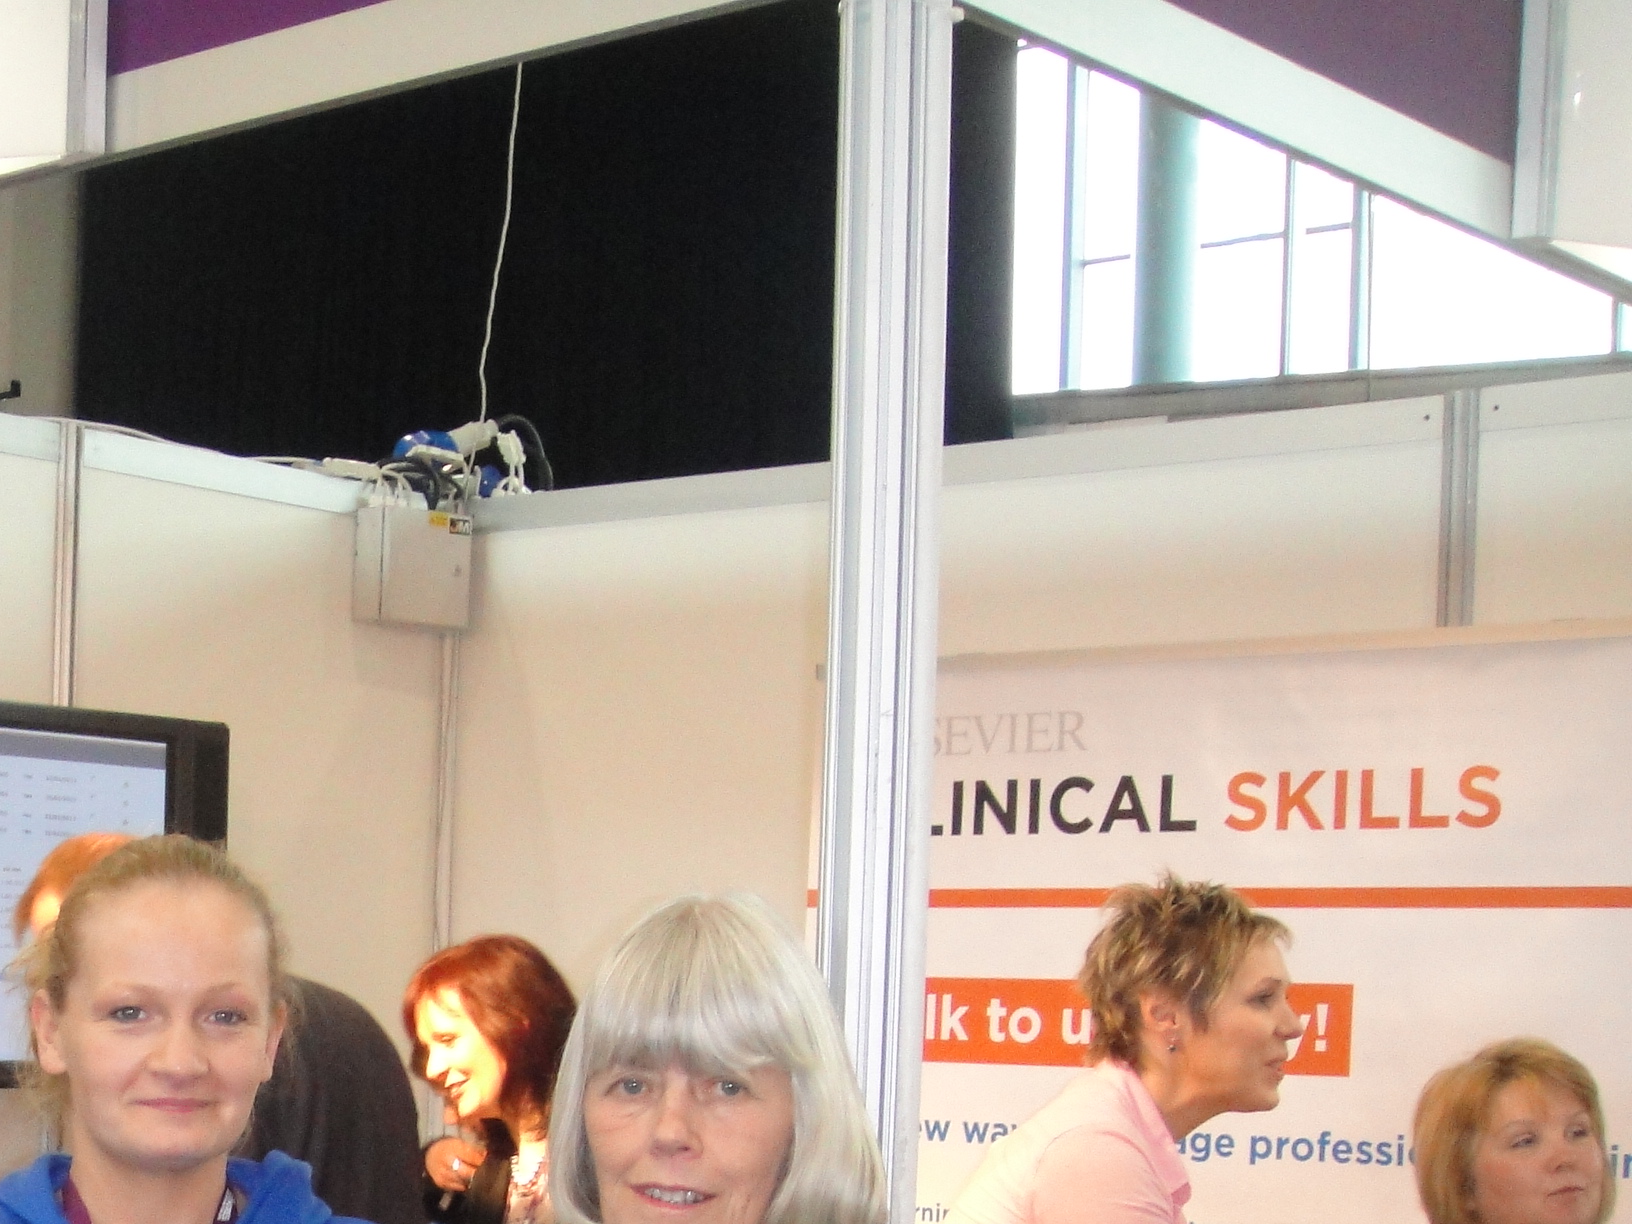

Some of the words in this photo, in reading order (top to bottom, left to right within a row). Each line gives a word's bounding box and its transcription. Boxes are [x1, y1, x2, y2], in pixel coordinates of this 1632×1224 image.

[931, 774, 1198, 836] INICAL
[1224, 764, 1502, 832] SKILLS
[986, 998, 1042, 1044] to
[1062, 1007, 1093, 1045] u
[963, 1120, 1019, 1145] wa
